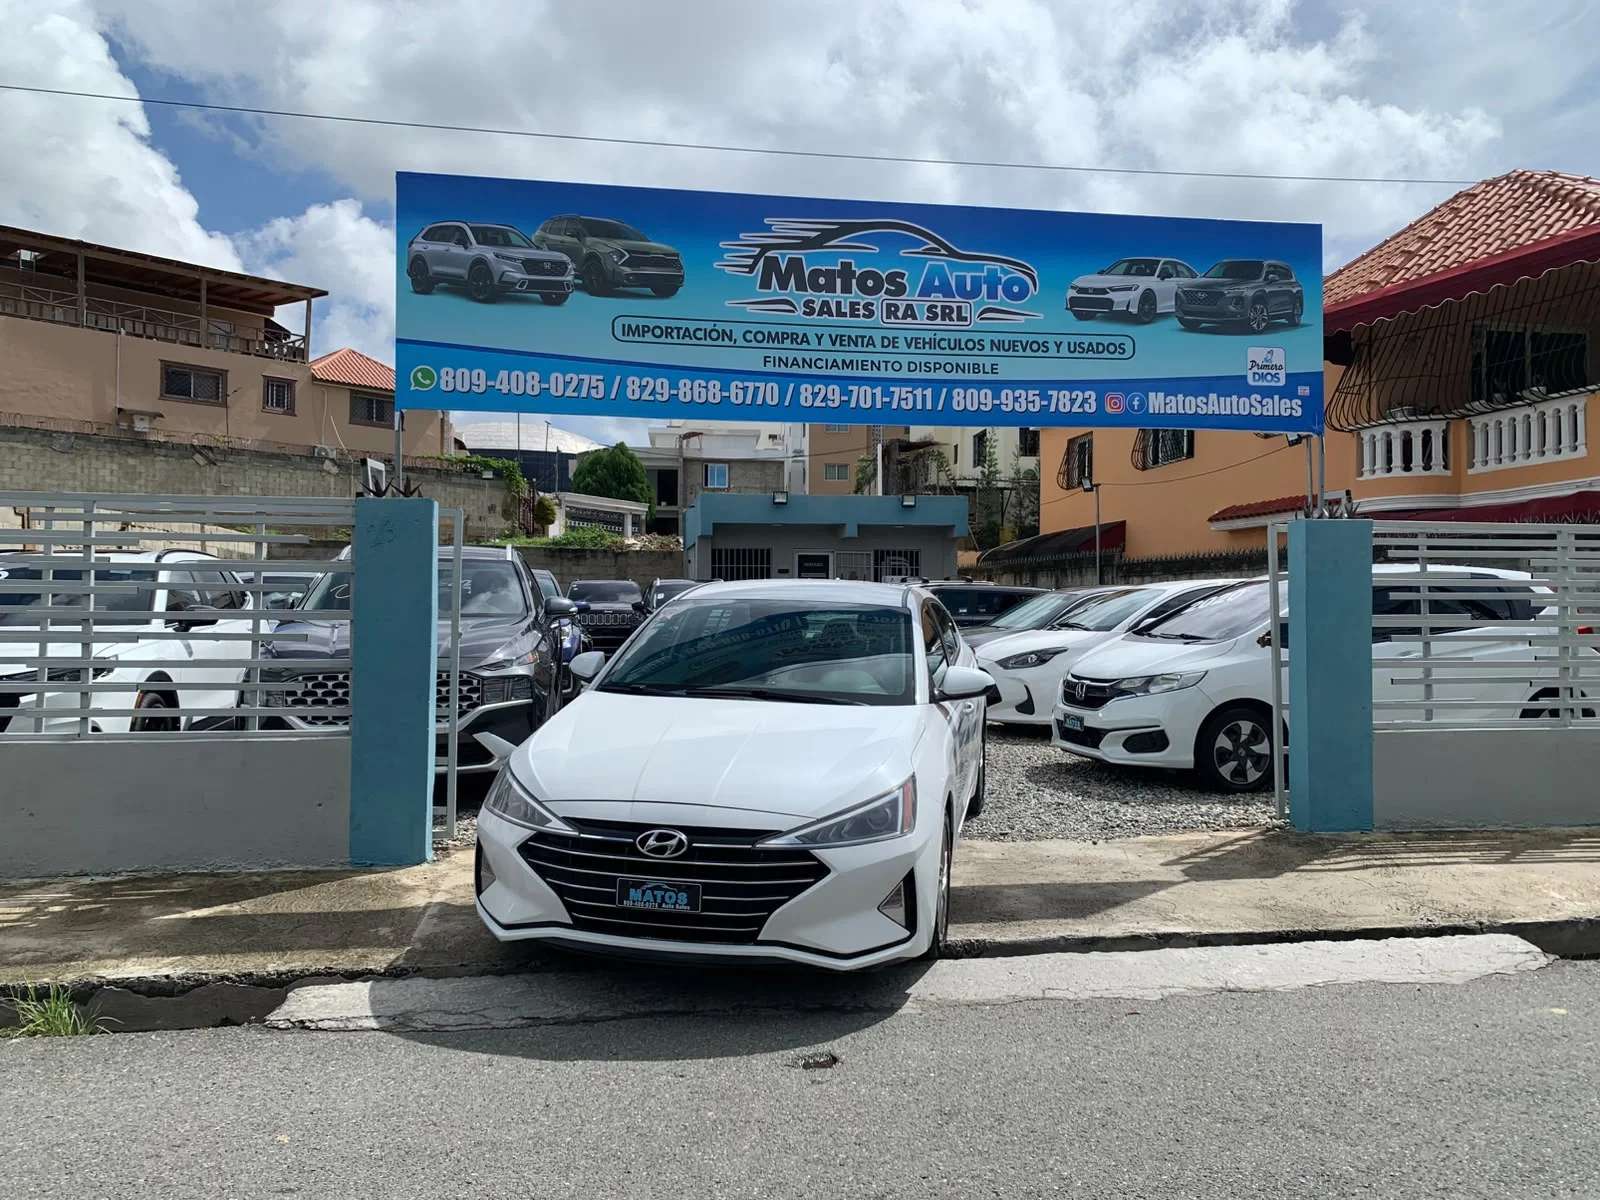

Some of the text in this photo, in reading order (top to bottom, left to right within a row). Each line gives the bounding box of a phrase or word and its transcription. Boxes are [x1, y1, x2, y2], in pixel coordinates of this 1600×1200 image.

[758, 255, 1033, 303] Matos Auto
[802, 299, 968, 323] SALES RA SRL
[621, 323, 1127, 355] IMPORTACIÓN, COMPRA Y VENTA DE VEHÍCULOS NUEVOS Y USADOS
[763, 355, 1000, 375] FINANCIAMIENTO DISPONIBLE
[1252, 372, 1280, 383] DIOS
[440, 367, 605, 400] 809-408-0275
[625, 375, 780, 406] 829-868-6770
[800, 384, 933, 411] 829-701-7511
[952, 387, 1098, 414] 809-935-7823
[1148, 391, 1303, 418] MatosAutoSales
[629, 888, 687, 904] MATOS
